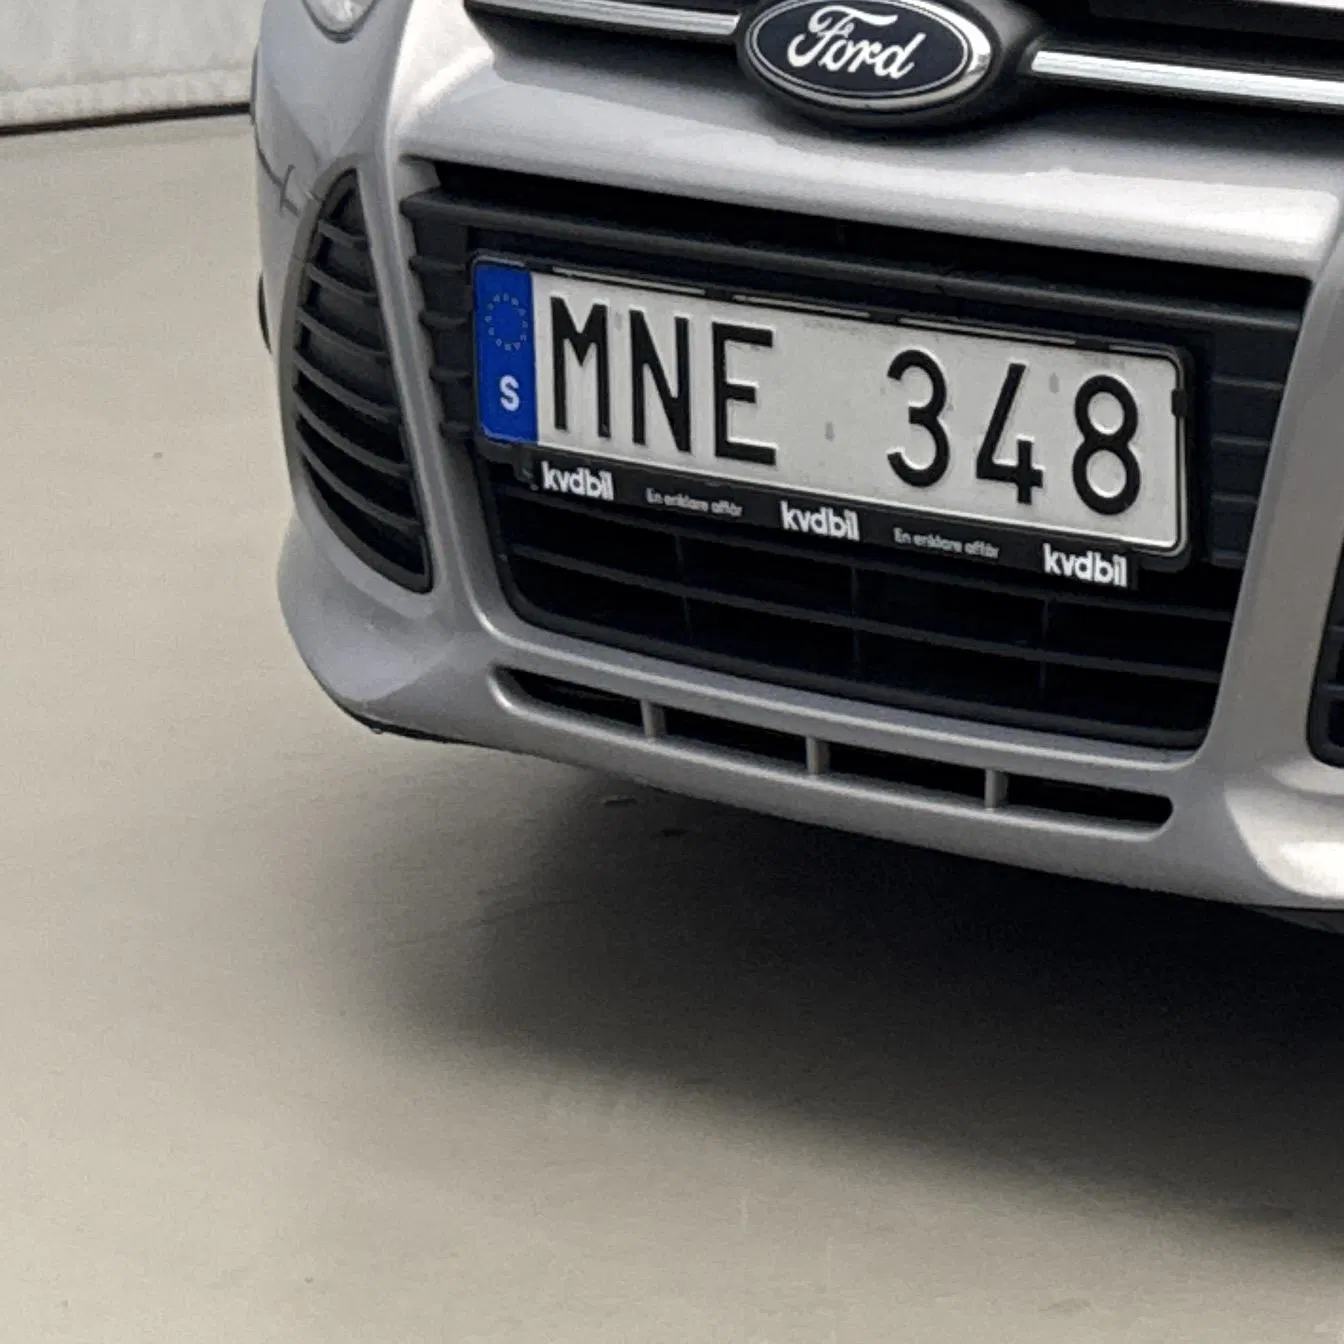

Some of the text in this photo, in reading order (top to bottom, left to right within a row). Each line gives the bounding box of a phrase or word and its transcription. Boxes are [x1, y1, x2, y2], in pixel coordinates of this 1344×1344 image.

[787, 5, 926, 80] Ford
[499, 374, 520, 412] S
[550, 295, 1142, 516] MNE 348
[541, 460, 615, 502] kvdbil
[780, 501, 861, 542] kvdbil
[1042, 543, 1128, 588] kvdbil
